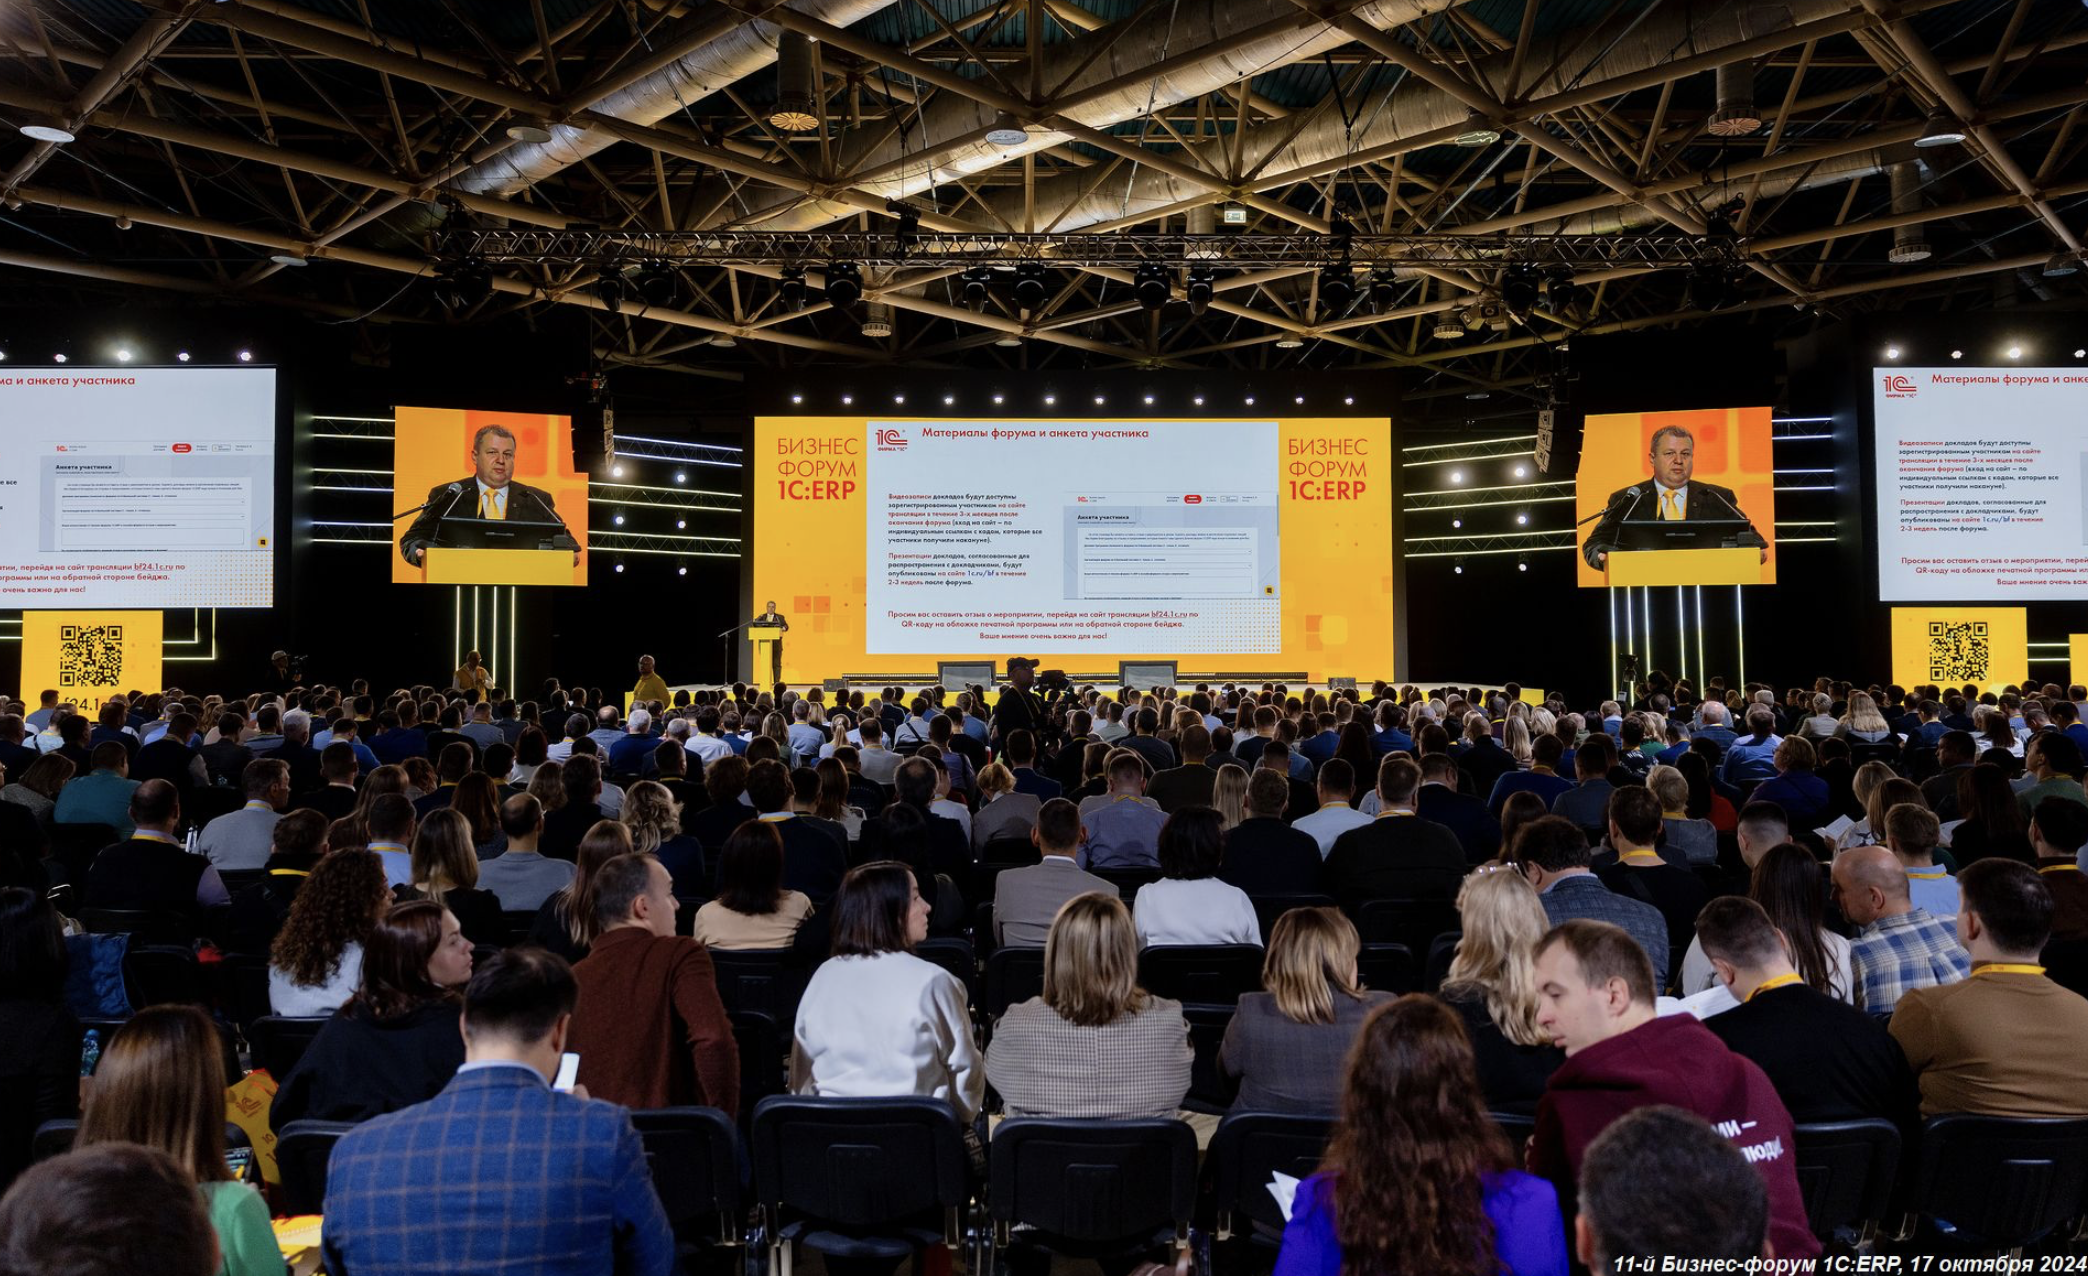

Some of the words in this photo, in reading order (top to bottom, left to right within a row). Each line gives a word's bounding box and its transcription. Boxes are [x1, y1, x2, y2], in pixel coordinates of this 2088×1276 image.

[73, 378, 136, 387] участника
[1932, 375, 2000, 384] Материалы
[2003, 375, 2049, 386] форума
[922, 428, 988, 437] Материалы
[991, 428, 1036, 440] форума
[1091, 431, 1149, 439] участника
[777, 438, 858, 455] БИЗНЕС
[1288, 438, 1368, 455] БИЗНЕС
[778, 460, 856, 477] ФОРУМ
[1288, 460, 1367, 478] ФОРУМ
[778, 480, 855, 500] 1С:ERP
[1288, 481, 1366, 500] 1С:ERP
[888, 611, 916, 619] Просим
[902, 620, 934, 628] QR-коду
